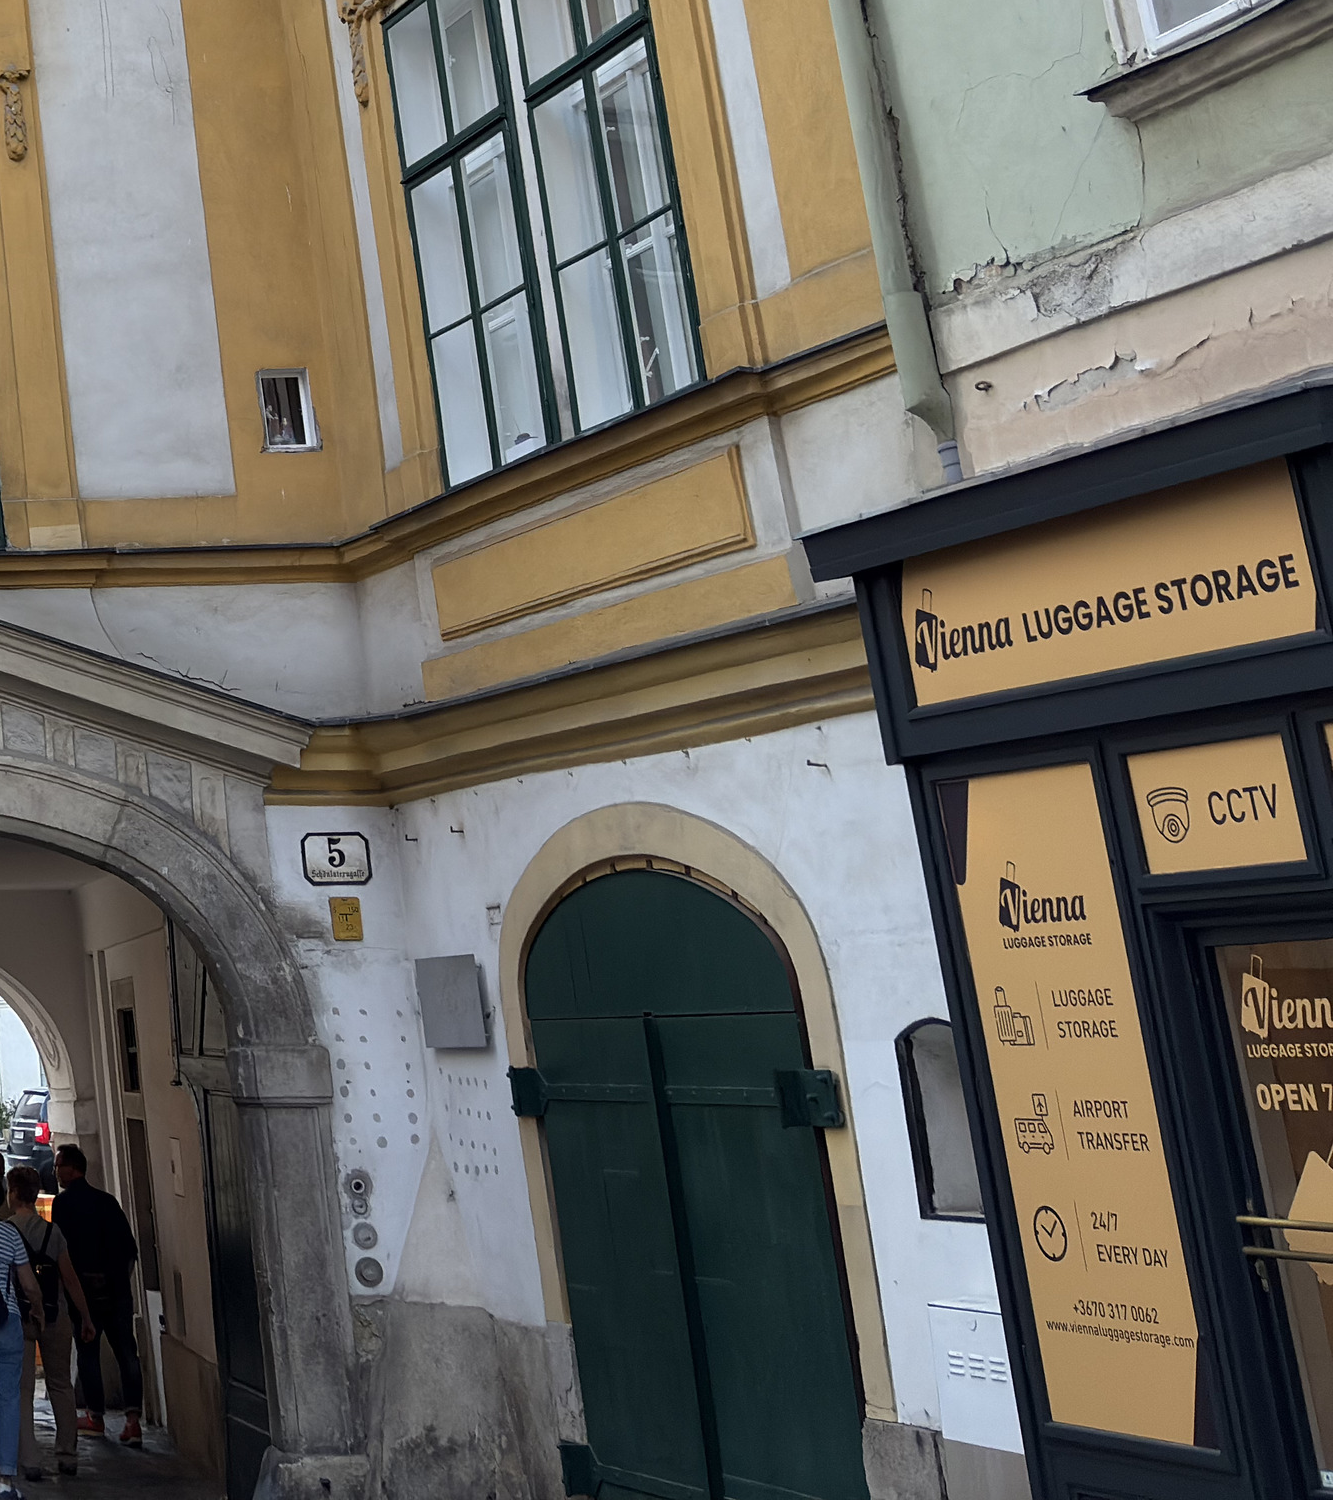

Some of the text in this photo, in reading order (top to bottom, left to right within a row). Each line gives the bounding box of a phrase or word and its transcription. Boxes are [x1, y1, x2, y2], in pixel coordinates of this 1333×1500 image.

[915, 553, 1300, 667] Vienna LUGGAGE STORAGE
[1207, 783, 1276, 825] CCTV
[327, 837, 346, 868] 5
[999, 887, 1087, 927] Vienna
[1003, 933, 1092, 949] LUGGAGE STORAGE
[1051, 988, 1114, 1007] LUGGAGE
[1057, 1020, 1119, 1039] STORAGE
[1246, 1043, 1303, 1058] LUGGAGE
[1073, 1100, 1129, 1119] AIRPORT
[1256, 1083, 1318, 1111] OPEN
[1077, 1131, 1150, 1152] TRANSFER
[1090, 1211, 1118, 1232] 24/7
[1096, 1243, 1168, 1268] EVERY DAY
[1073, 1299, 1160, 1325] +3670 317 0062
[1046, 1319, 1195, 1349] www.viennaluggagestorage.com
